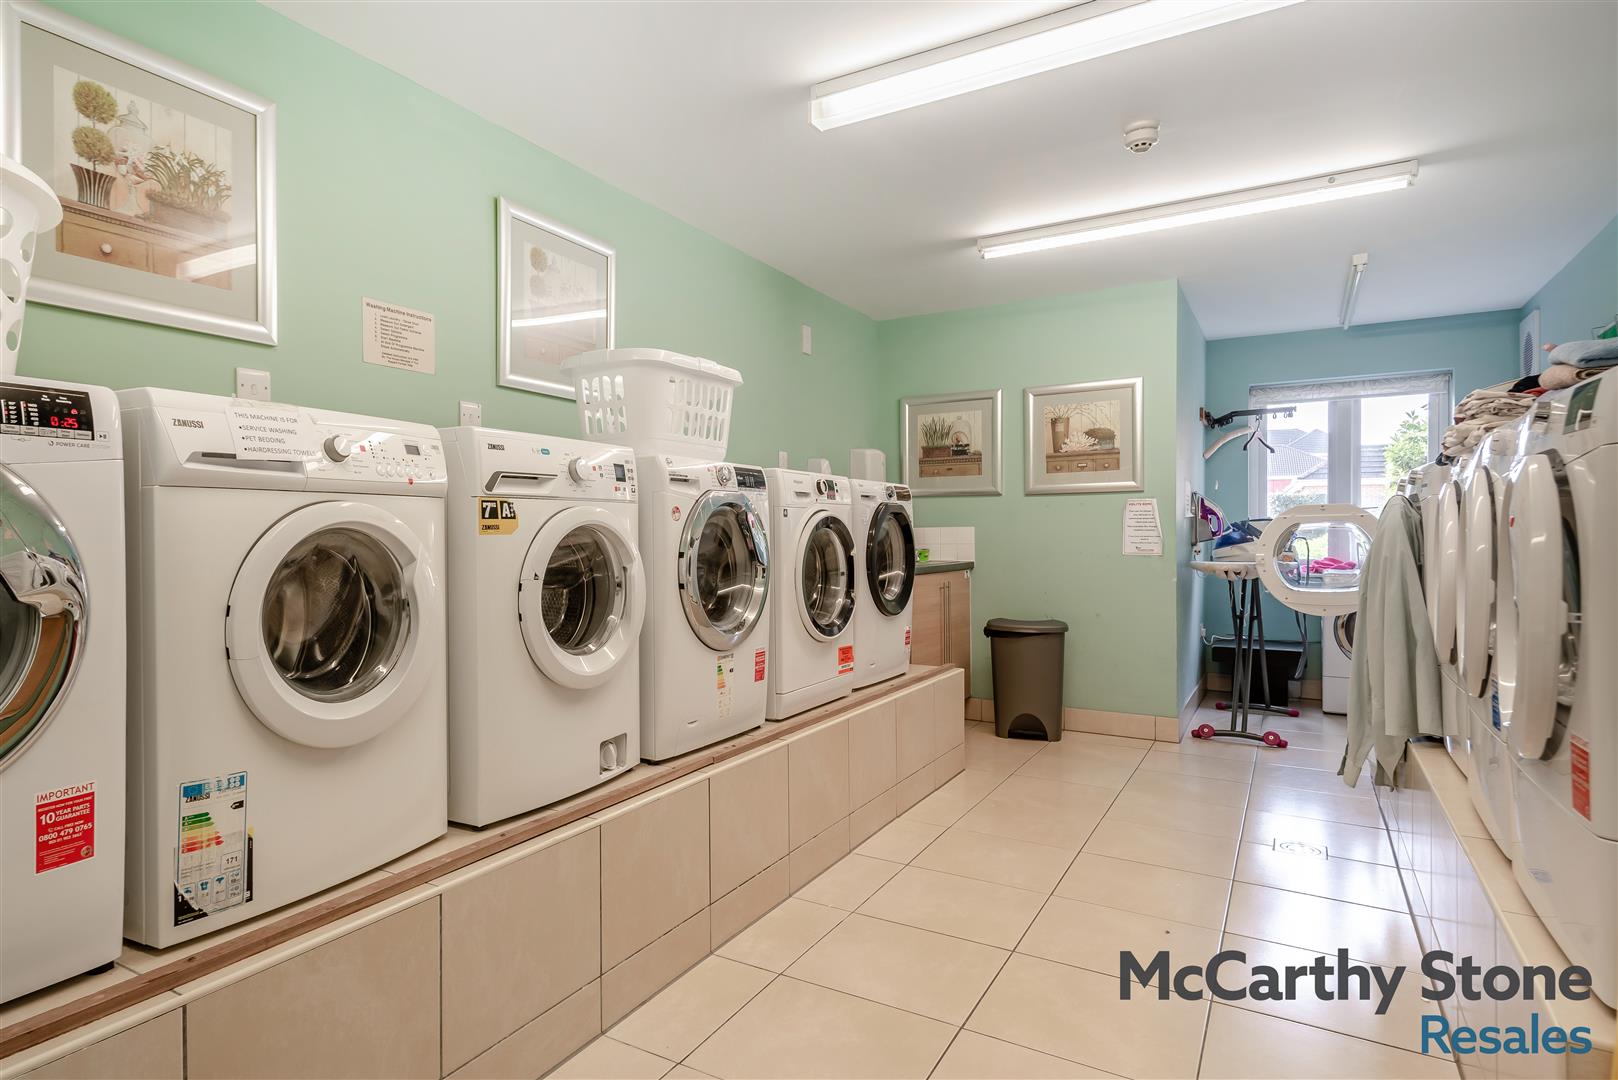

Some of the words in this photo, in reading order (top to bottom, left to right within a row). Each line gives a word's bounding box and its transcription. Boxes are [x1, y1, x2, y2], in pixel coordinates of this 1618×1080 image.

[366, 303, 386, 312] Washing
[387, 308, 405, 316] Machine
[406, 313, 431, 322] Instructions
[172, 418, 204, 428] ZANUSSI
[250, 414, 278, 422] MACHINE
[242, 425, 267, 433] SERVICE
[269, 427, 297, 435] WASHING
[248, 446, 292, 455] HAIRDRESSING
[37, 782, 95, 803] IMPORTANT
[185, 792, 210, 803] ZANUSSI
[40, 811, 55, 826] 10
[56, 807, 71, 816] YEAR
[73, 802, 90, 812] PARTS
[56, 808, 90, 822] GUARANTEE
[39, 831, 58, 842] 0800
[60, 827, 73, 837] 479
[75, 822, 92, 833] 0765
[225, 856, 238, 864] 171
